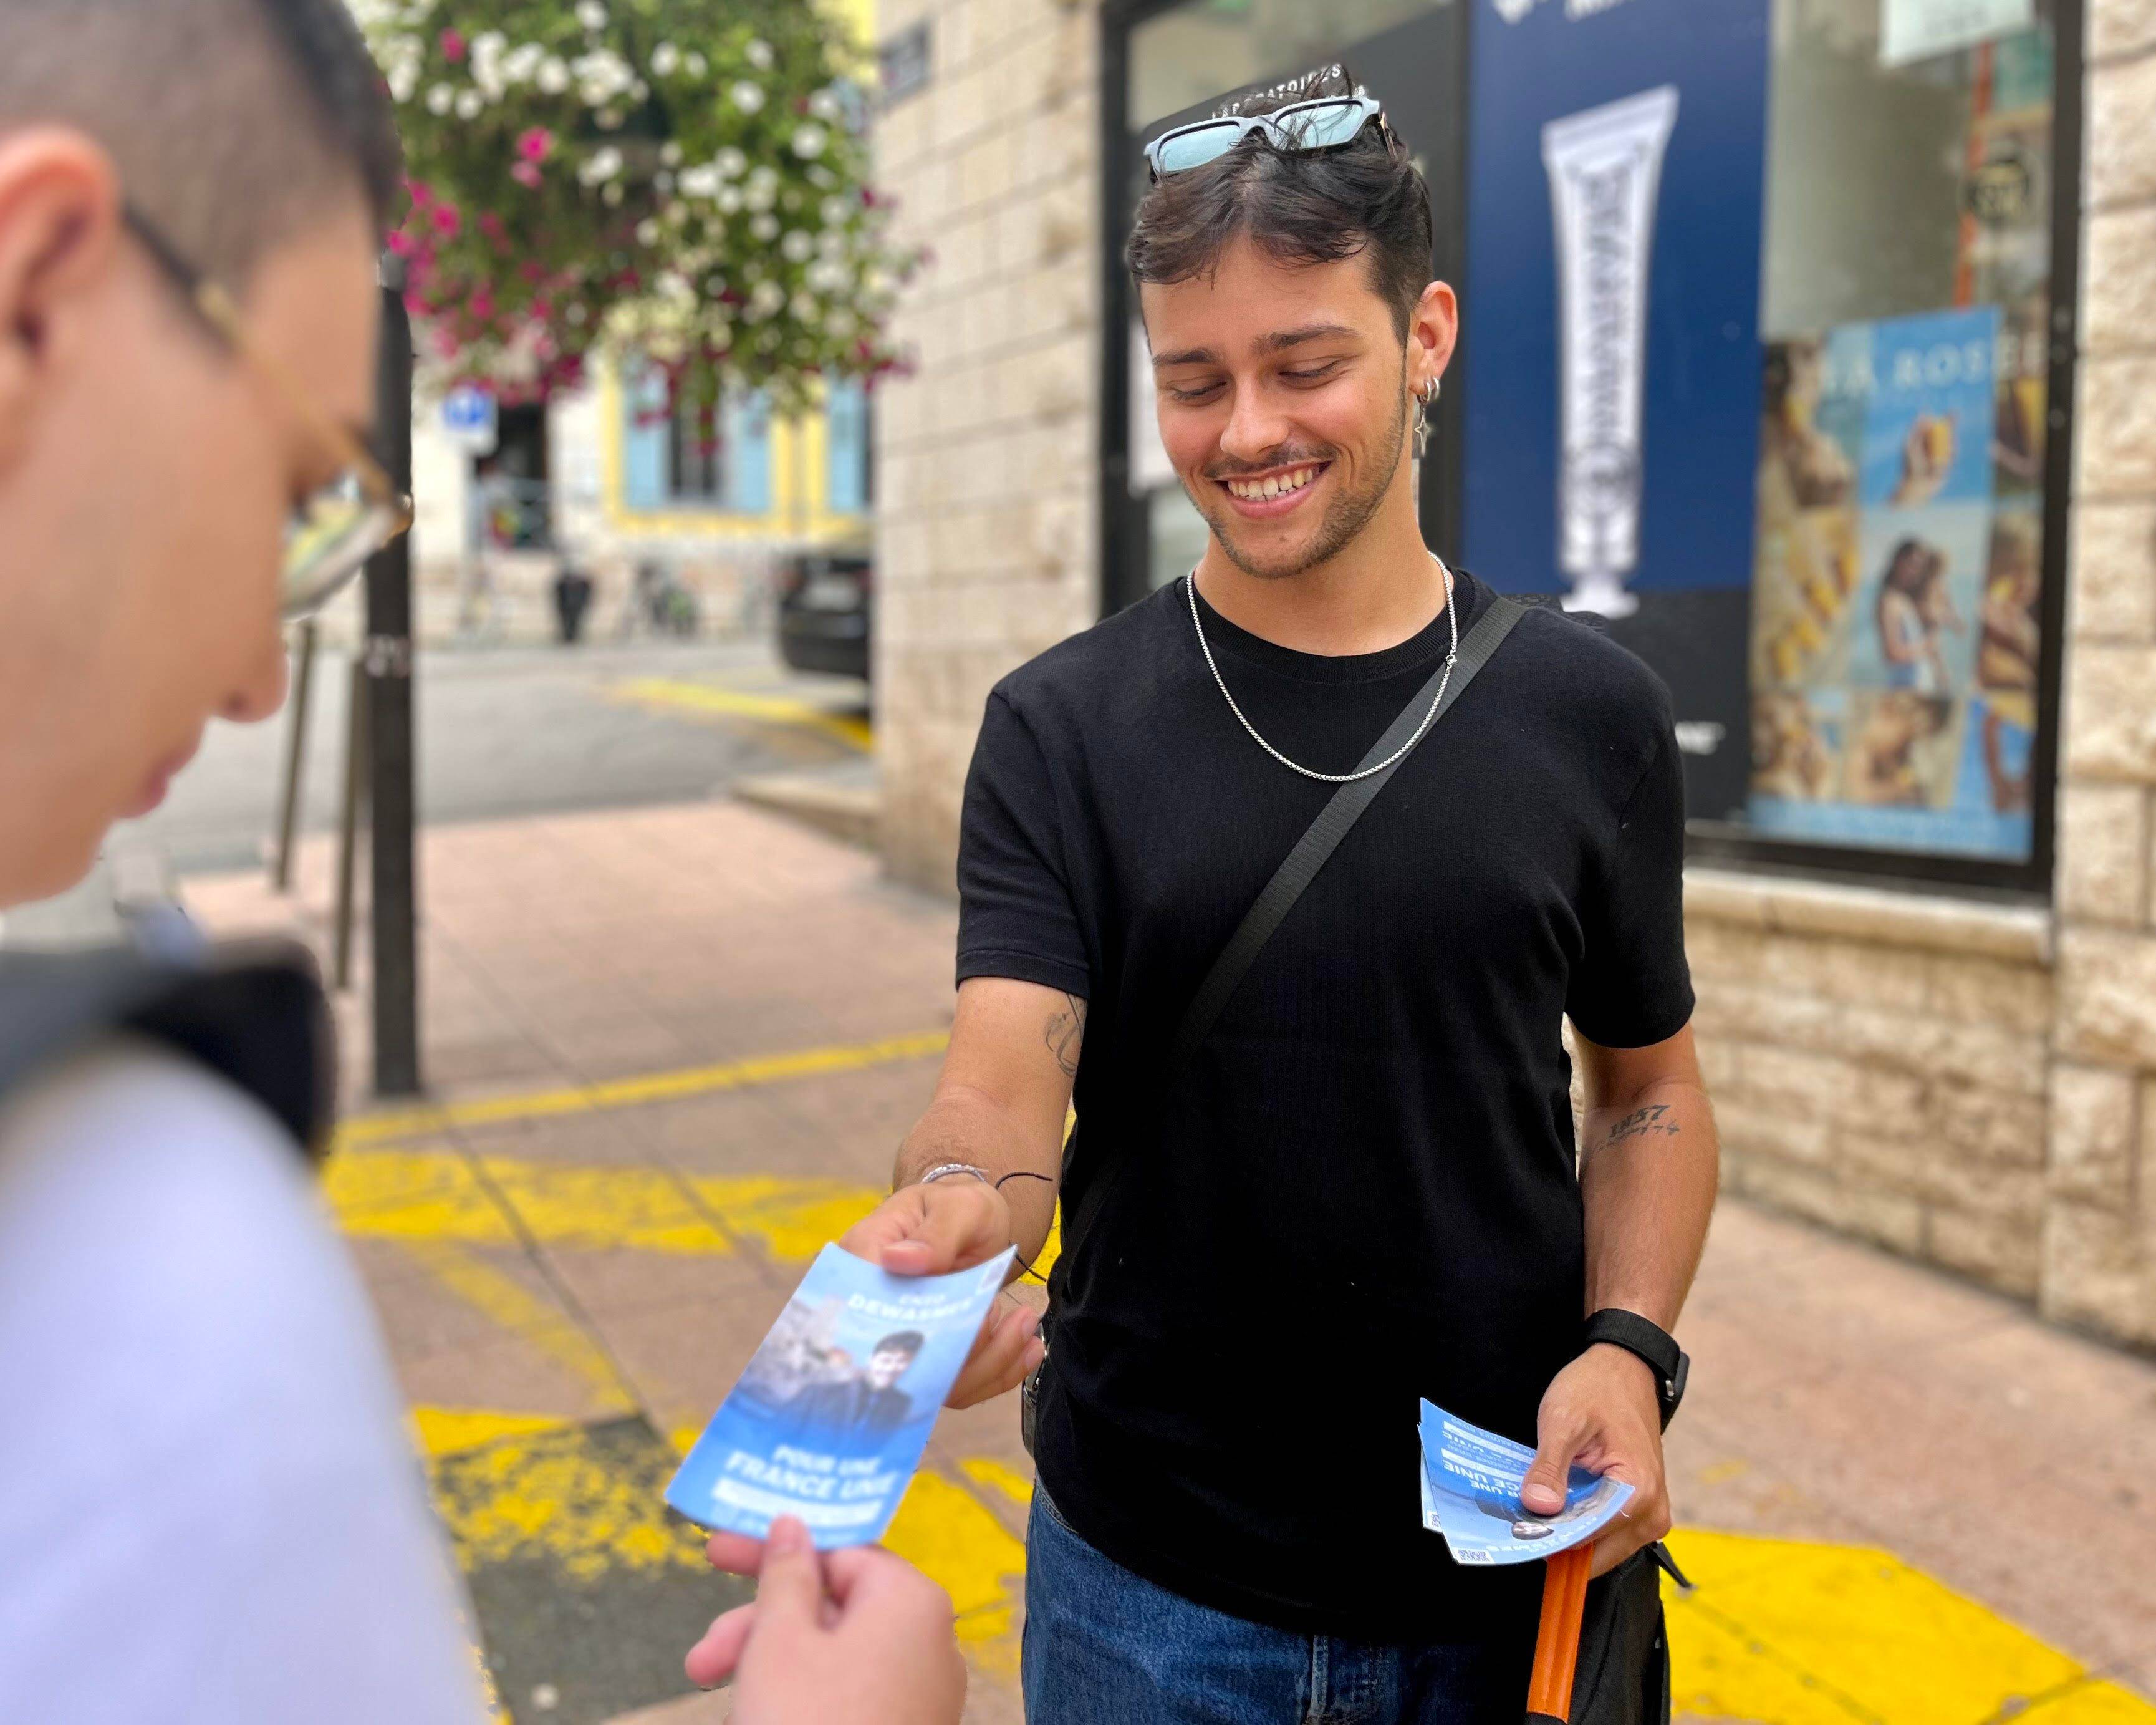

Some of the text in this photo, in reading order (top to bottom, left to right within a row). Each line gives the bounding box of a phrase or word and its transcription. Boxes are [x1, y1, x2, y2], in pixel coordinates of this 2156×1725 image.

[725, 1449, 837, 1499] FRANCE
[1442, 1459, 1488, 1484] UNIE
[1469, 1479, 1503, 1495] UNE
